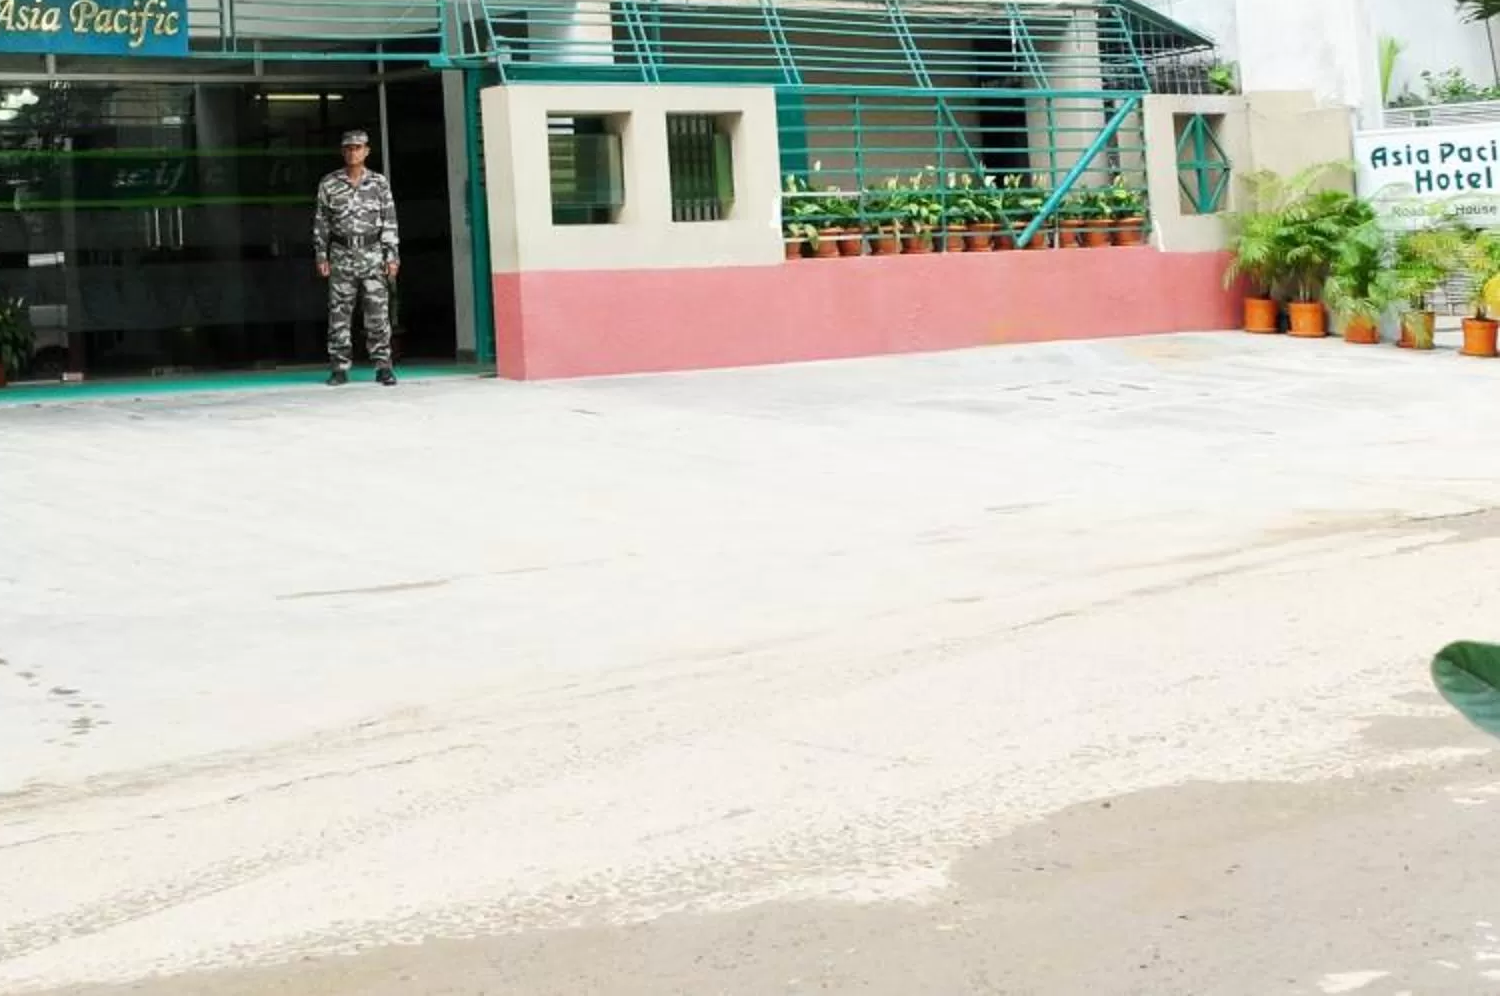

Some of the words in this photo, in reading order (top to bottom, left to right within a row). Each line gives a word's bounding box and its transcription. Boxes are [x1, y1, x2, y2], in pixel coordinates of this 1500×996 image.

[1370, 144, 1430, 169] Asia
[1438, 139, 1498, 164] Paci
[1414, 166, 1493, 194] Hotel
